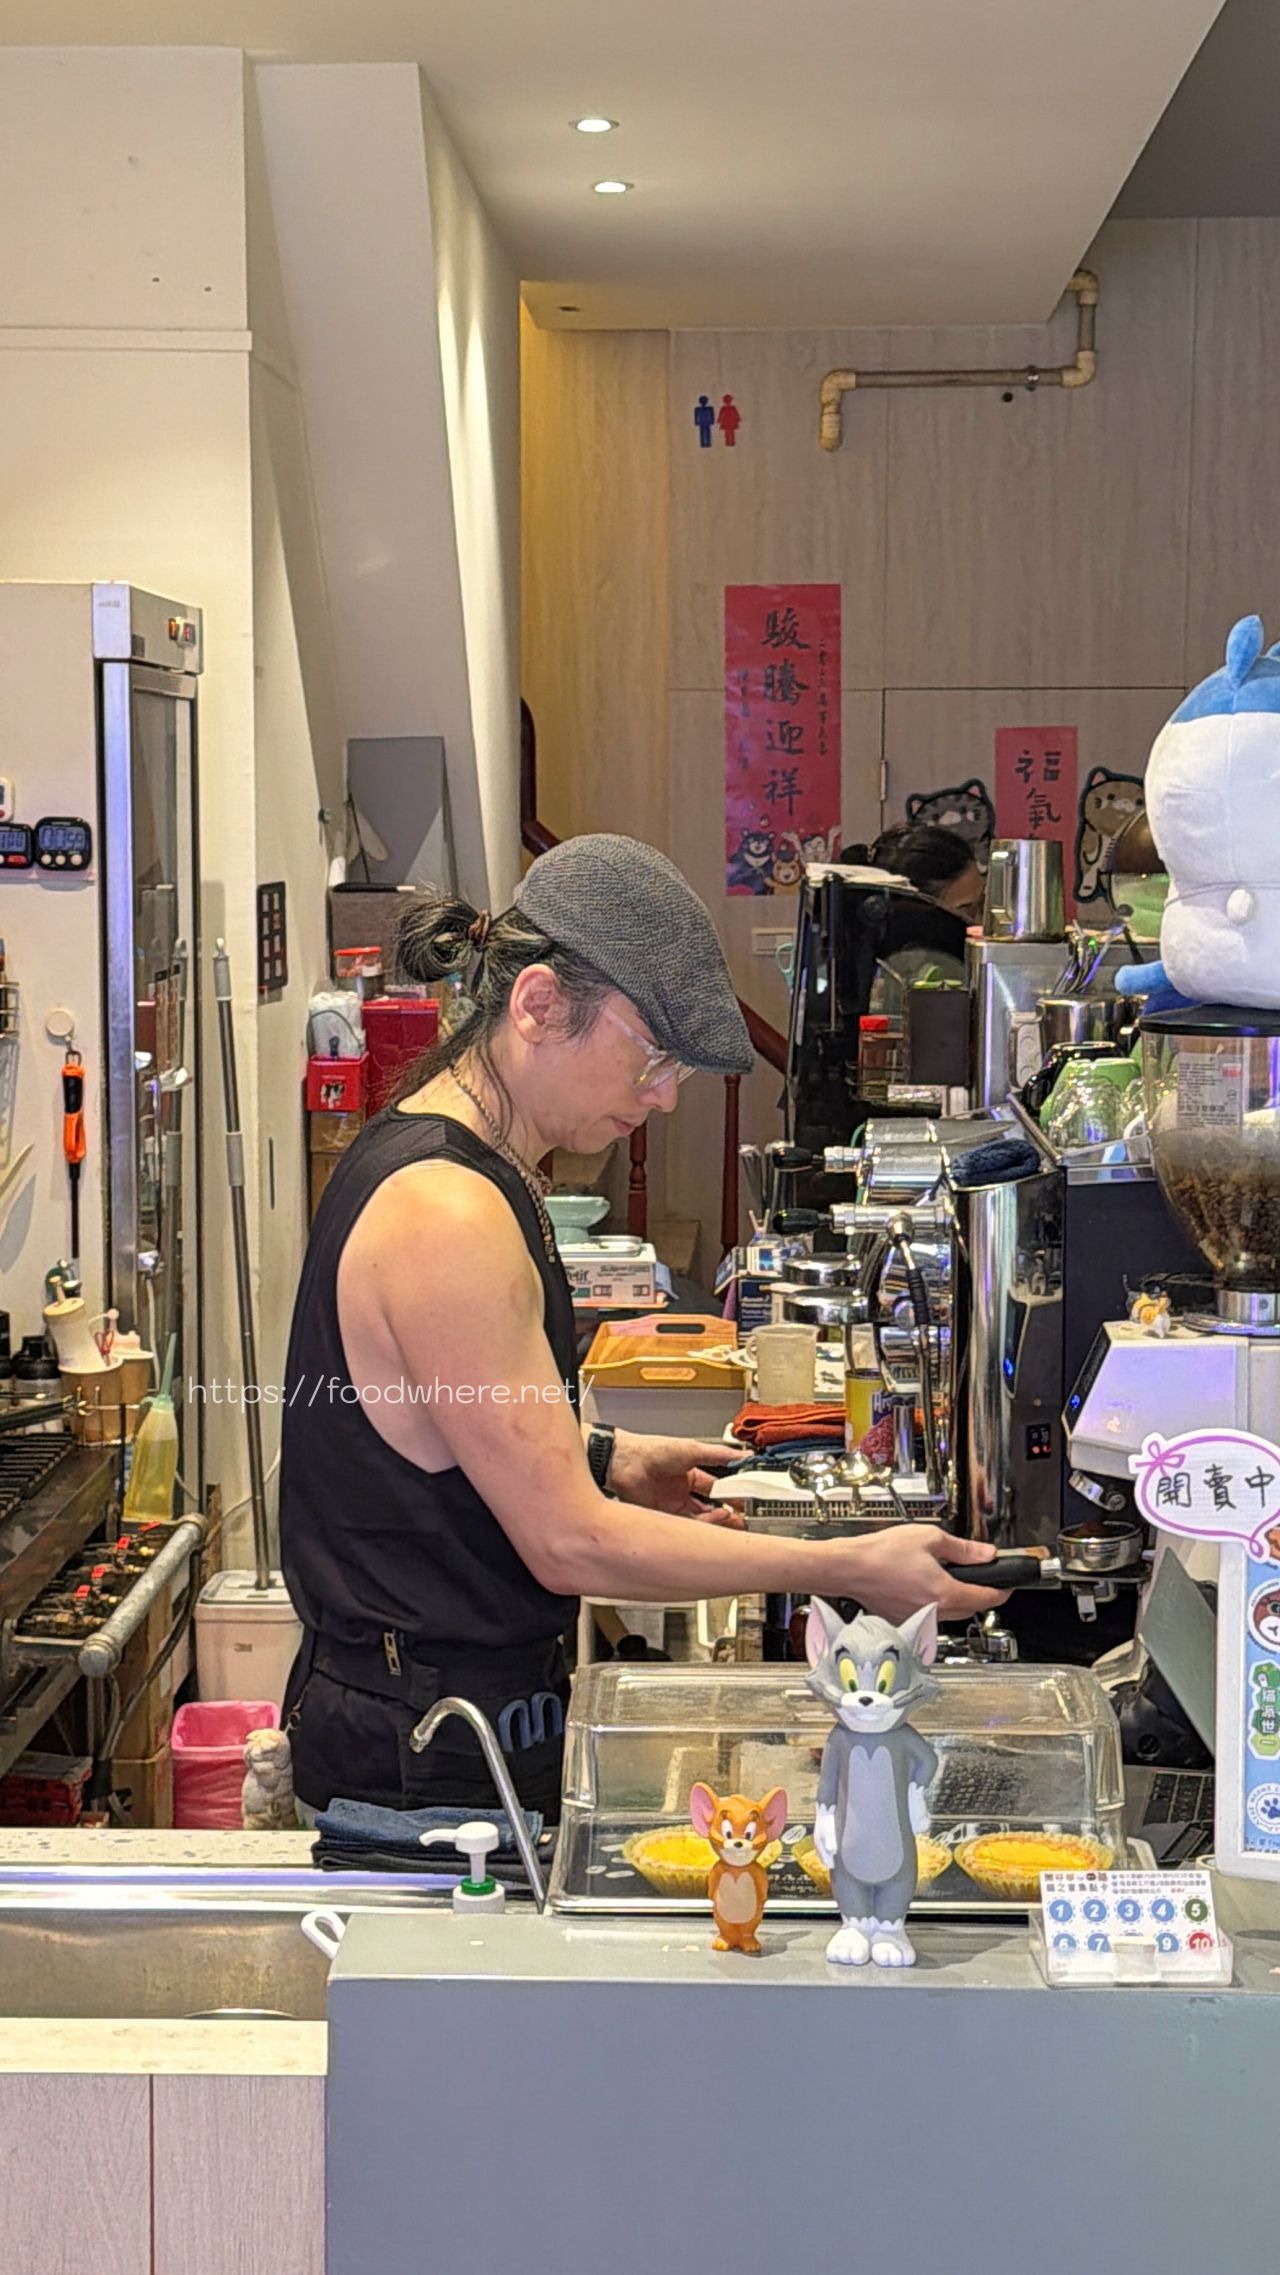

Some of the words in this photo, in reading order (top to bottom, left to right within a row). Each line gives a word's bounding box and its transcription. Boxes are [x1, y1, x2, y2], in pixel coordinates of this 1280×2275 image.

[762, 607, 810, 816] 駿騰迎祥
[1015, 749, 1062, 838] 福氣
[1156, 1463, 1275, 1511] 開賣中
[1056, 1904, 1065, 1917] 1
[1090, 1904, 1099, 1917] 2
[1124, 1904, 1134, 1917] 3
[1156, 1903, 1167, 1917] 4
[1191, 1903, 1201, 1917] 5
[1094, 1938, 1104, 1951] 7
[1162, 1937, 1172, 1950] 9
[1193, 1937, 1210, 1950] 10
